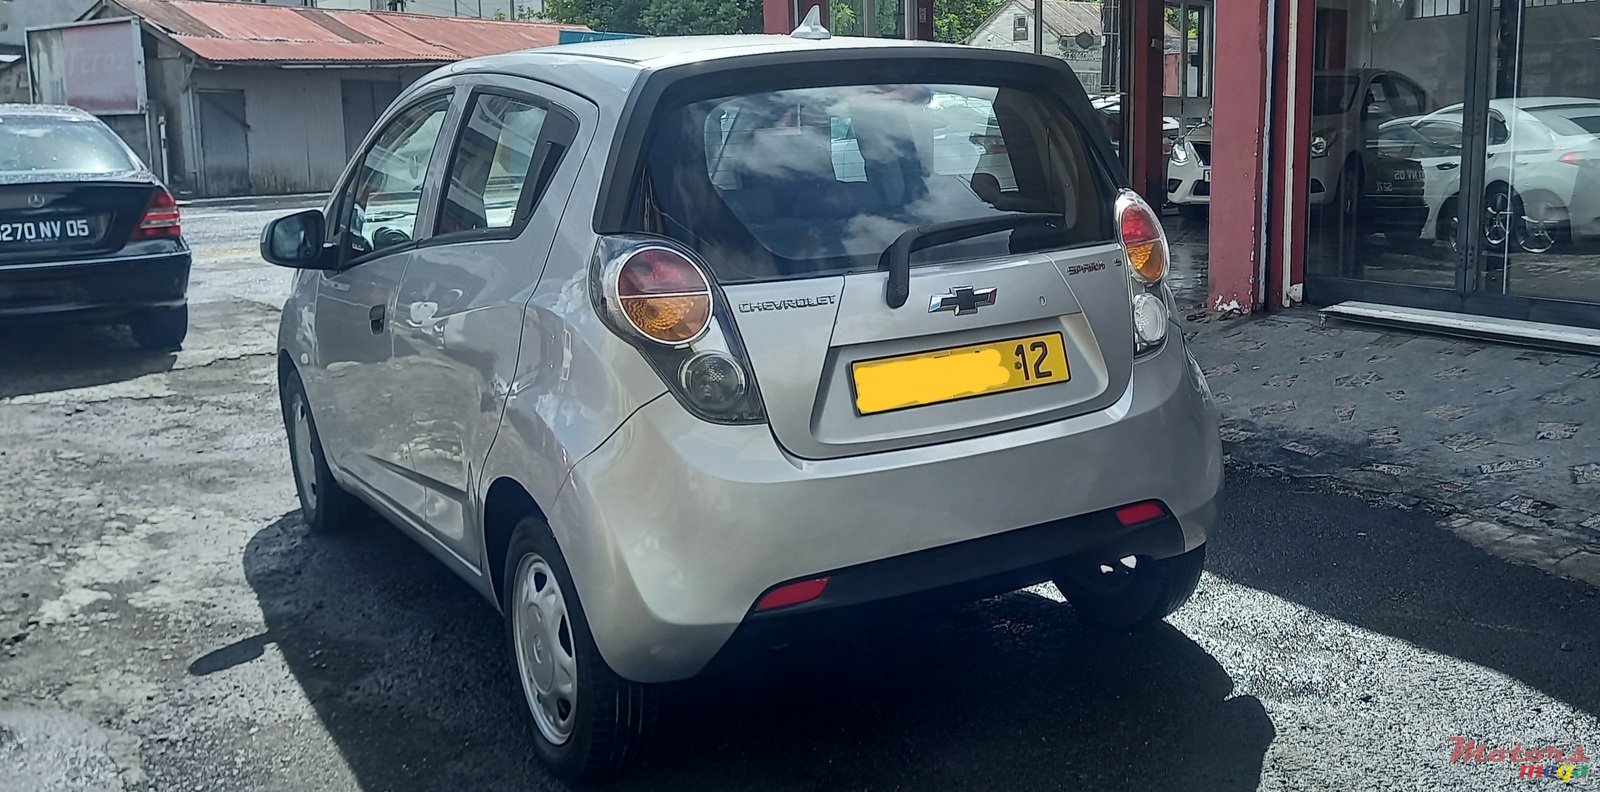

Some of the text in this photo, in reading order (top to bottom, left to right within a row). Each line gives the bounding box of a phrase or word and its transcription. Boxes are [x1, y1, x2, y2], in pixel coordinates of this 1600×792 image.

[0, 219, 90, 241] 270 NV 05
[738, 294, 836, 314] CHEVROLET
[1014, 340, 1053, 381] 12
